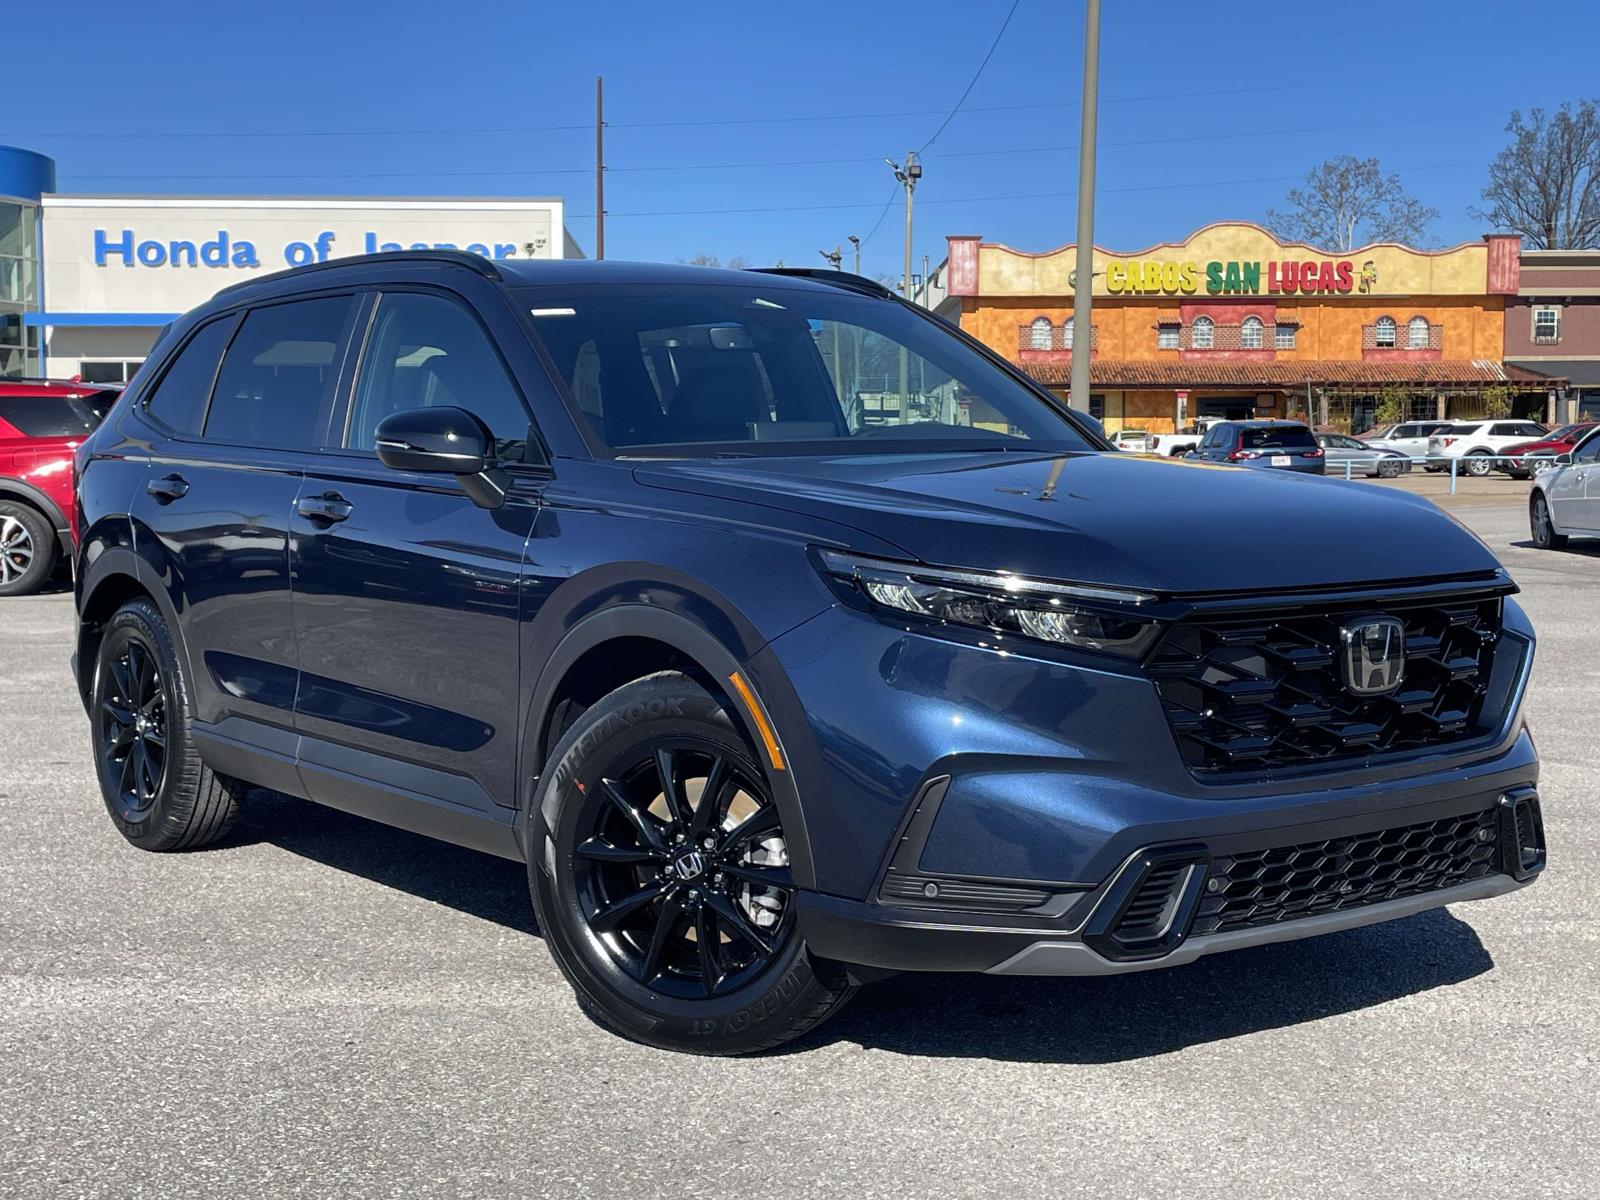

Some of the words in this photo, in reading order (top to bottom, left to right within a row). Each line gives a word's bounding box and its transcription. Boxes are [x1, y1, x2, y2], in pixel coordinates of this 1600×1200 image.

[94, 230, 260, 267] Honda
[284, 231, 335, 266] of
[1106, 261, 1198, 294] CABOS
[1205, 261, 1260, 294] SAN
[1267, 261, 1354, 294] LUCAS
